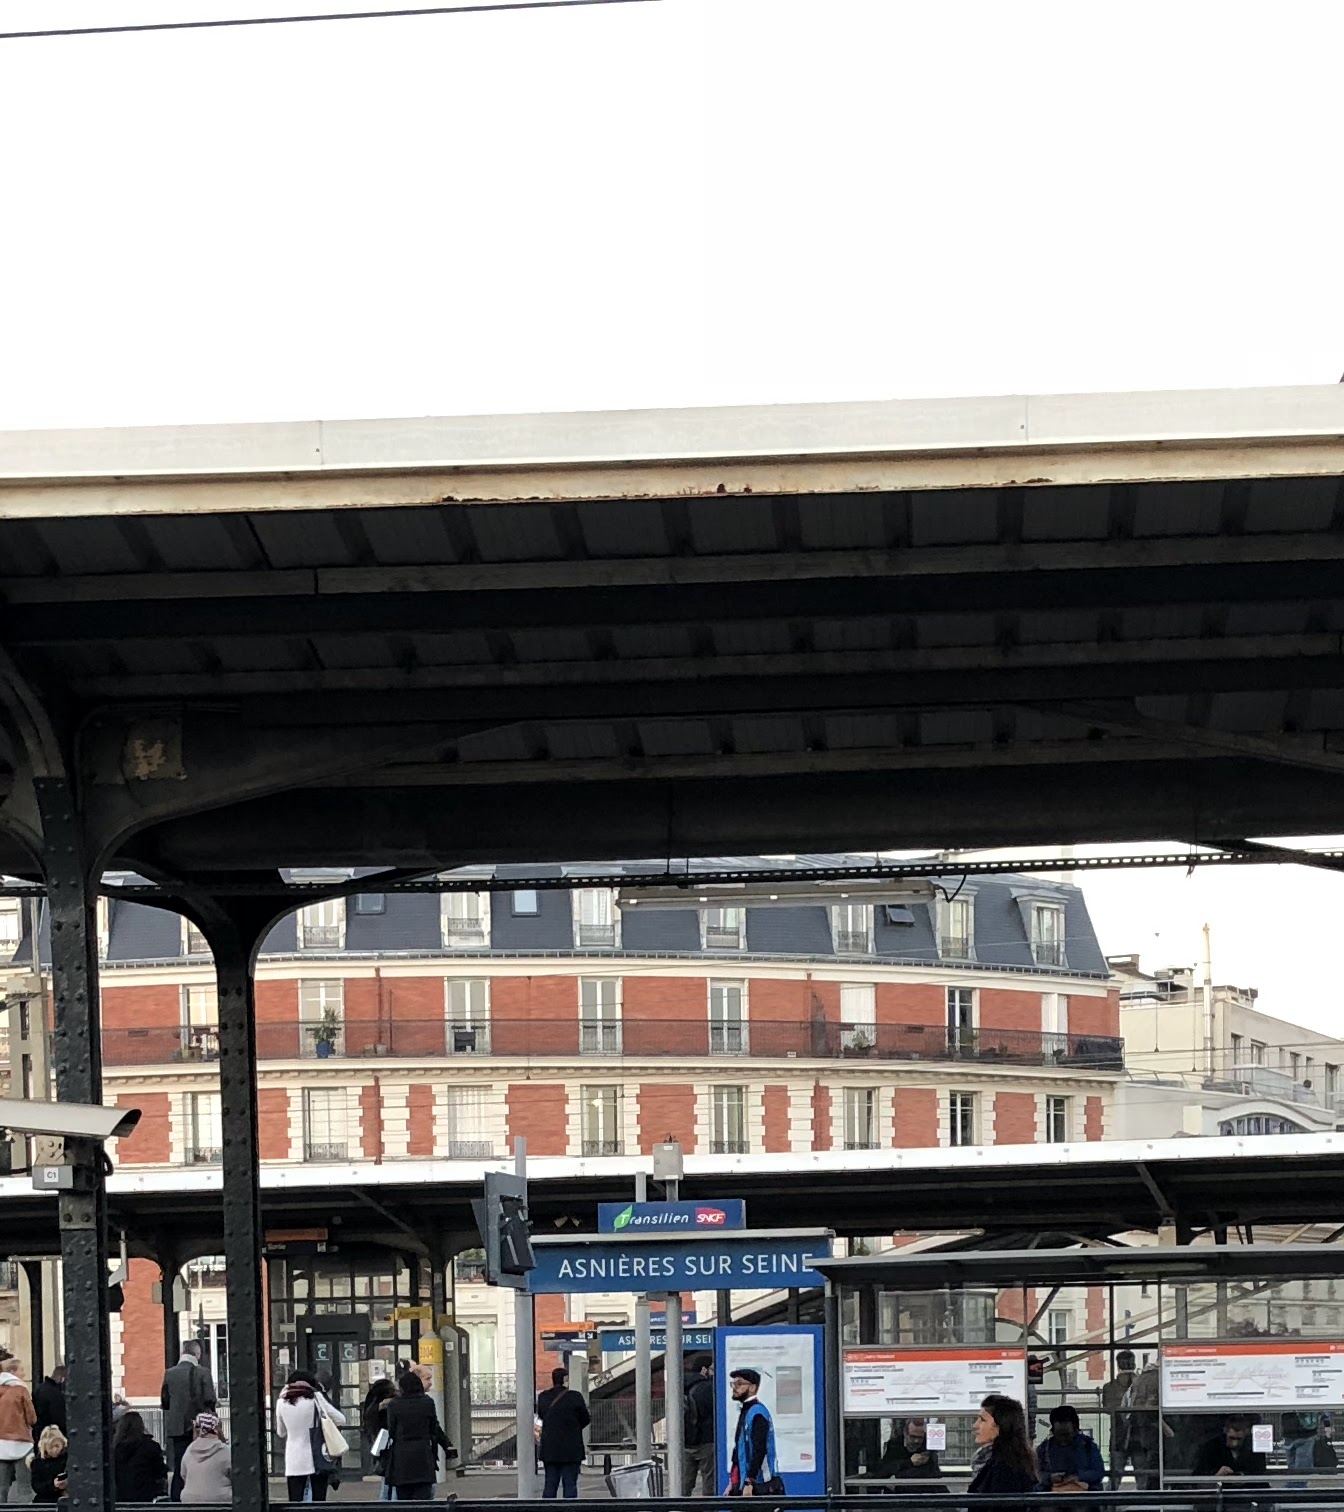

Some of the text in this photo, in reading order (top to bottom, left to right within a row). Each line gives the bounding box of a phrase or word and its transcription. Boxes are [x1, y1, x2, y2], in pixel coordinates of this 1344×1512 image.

[47, 1171, 57, 1179] C1
[619, 1212, 689, 1225] Transilien
[696, 1213, 725, 1224] SNCF
[558, 1253, 814, 1279] ASNIÈRES SUR SEINE
[318, 1349, 326, 1359] C
[344, 1348, 353, 1359] C
